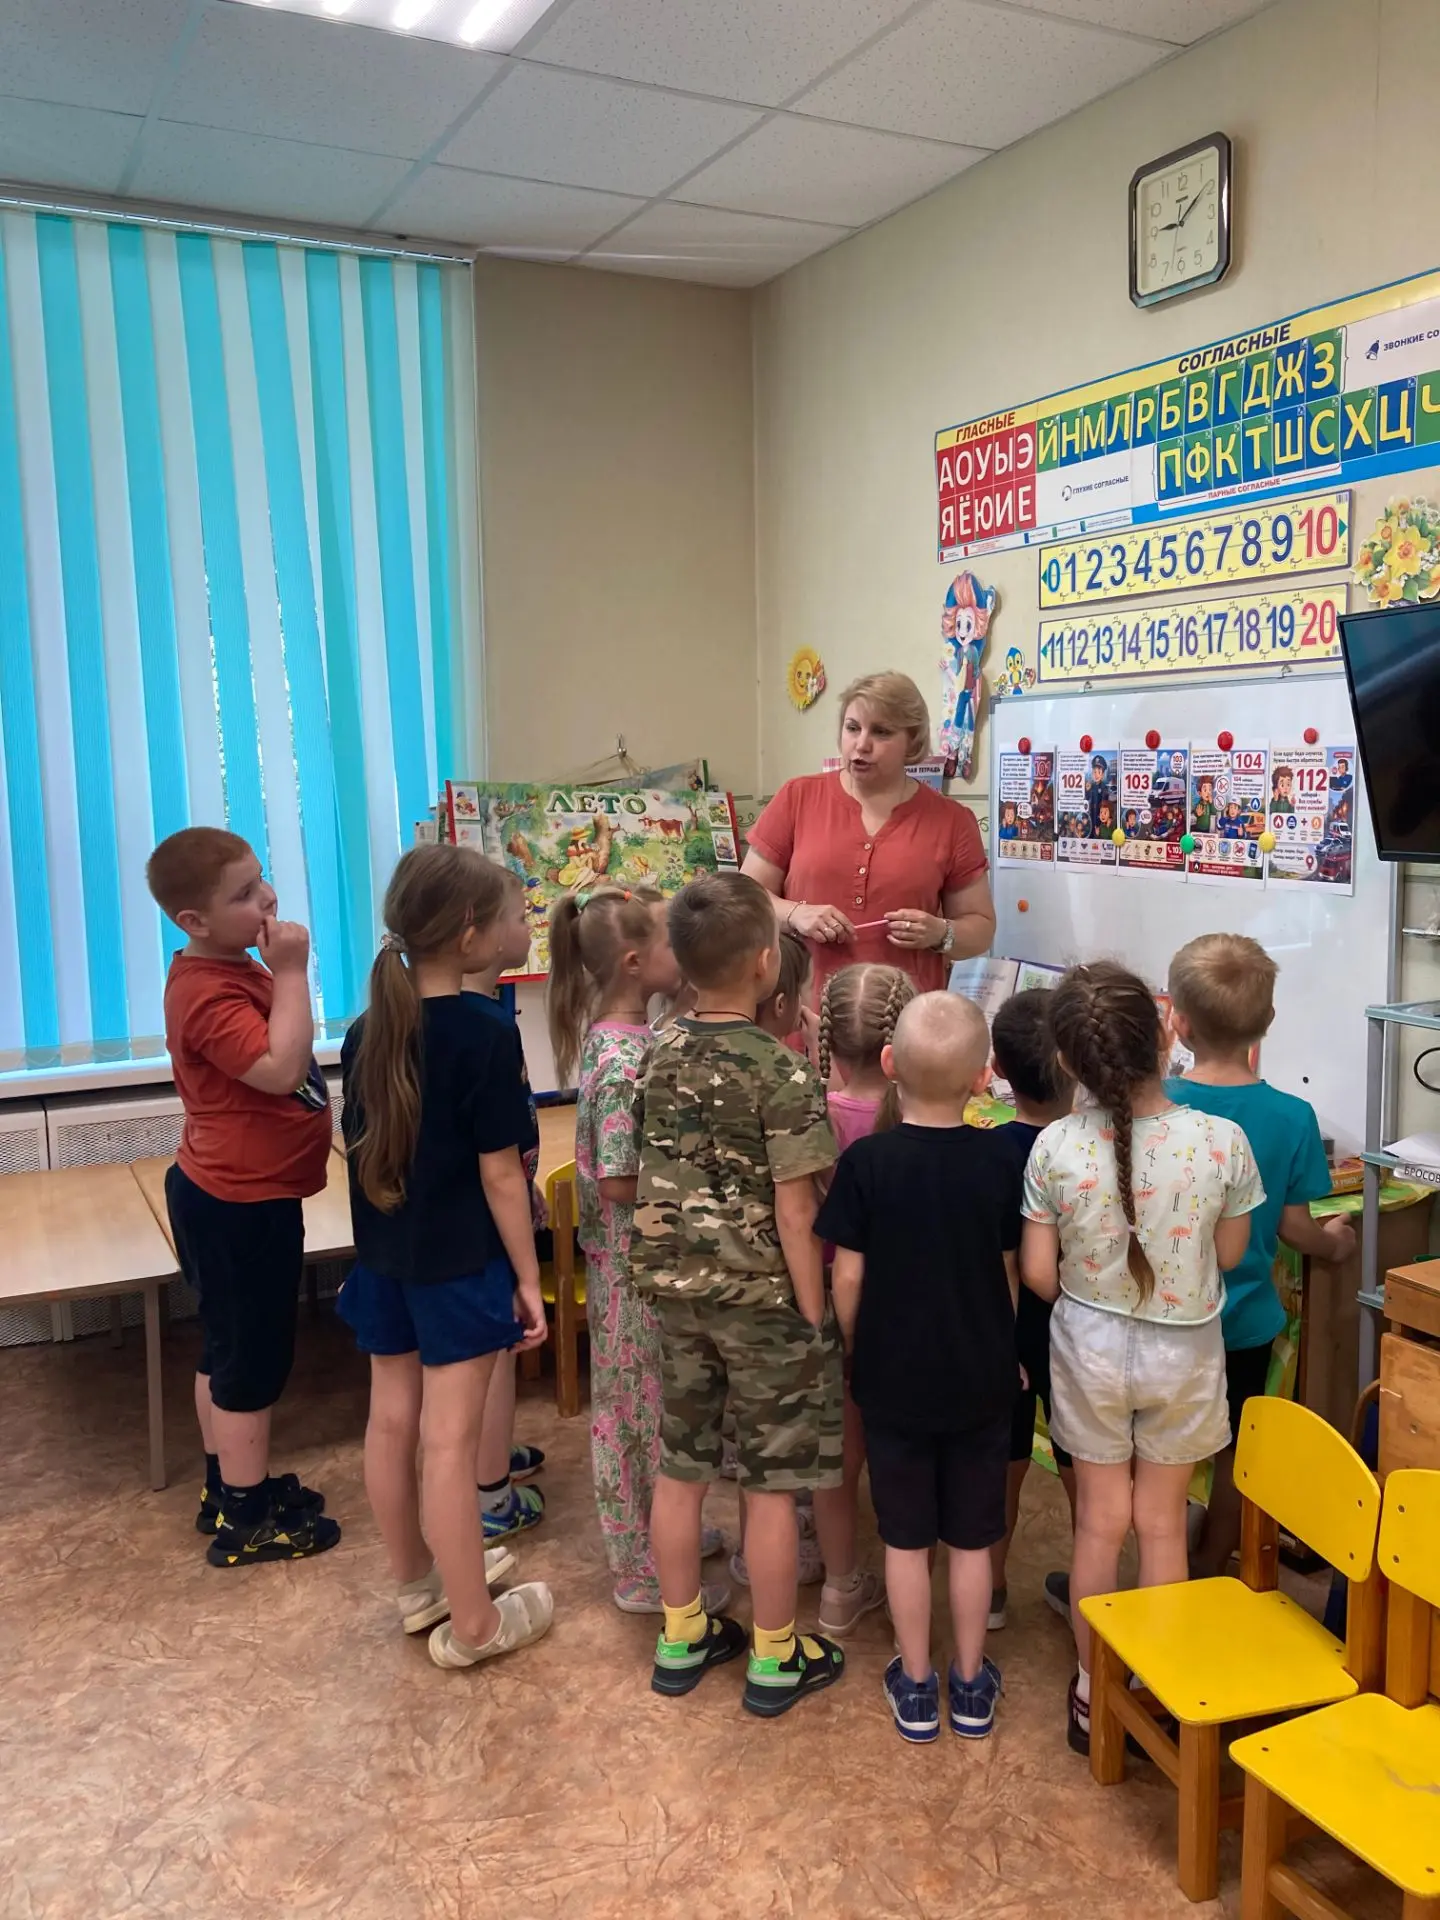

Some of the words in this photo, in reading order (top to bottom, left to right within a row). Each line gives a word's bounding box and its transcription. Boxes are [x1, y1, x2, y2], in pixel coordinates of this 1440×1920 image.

[1207, 204, 1216, 219] 3
[1177, 257, 1186, 275] 6
[1194, 250, 1203, 266] 5
[1178, 323, 1291, 373] СОГЛАСНЫЕ
[1383, 333, 1425, 351] ЗВОНКИЕ
[955, 412, 1016, 443] ГЛАСНЫЕ
[1093, 475, 1129, 489] СОГЛАСНЫЕ
[1207, 487, 1237, 499] ПАРНЫЕ
[1237, 477, 1281, 493] СОГЛАСНЫЕ
[1047, 557, 1061, 593] 0
[1065, 551, 1076, 593] 1
[1086, 548, 1103, 591] 2
[1110, 544, 1127, 587] 3
[1133, 539, 1152, 582] 4
[1159, 534, 1178, 579] 5
[1185, 530, 1205, 575] 6
[1213, 524, 1233, 571] 7
[1241, 519, 1262, 567] 8
[1271, 514, 1293, 563] 9
[1298, 506, 1338, 559] 10
[1047, 631, 1064, 669] 11
[1067, 628, 1089, 667] 12
[1092, 625, 1113, 664] 13
[1118, 622, 1142, 662] 14
[1146, 619, 1169, 660] 15
[1174, 615, 1199, 657] 16
[1202, 611, 1228, 655] 17
[1233, 607, 1261, 652] 18
[1266, 604, 1295, 649] 19
[1300, 599, 1336, 646] 20
[1033, 760, 1051, 777] 101
[1235, 753, 1263, 769] 104
[1061, 773, 1083, 789] 102
[1125, 774, 1150, 790] 103
[1296, 768, 1328, 792] 112
[546, 791, 648, 816] ЛЕТО
